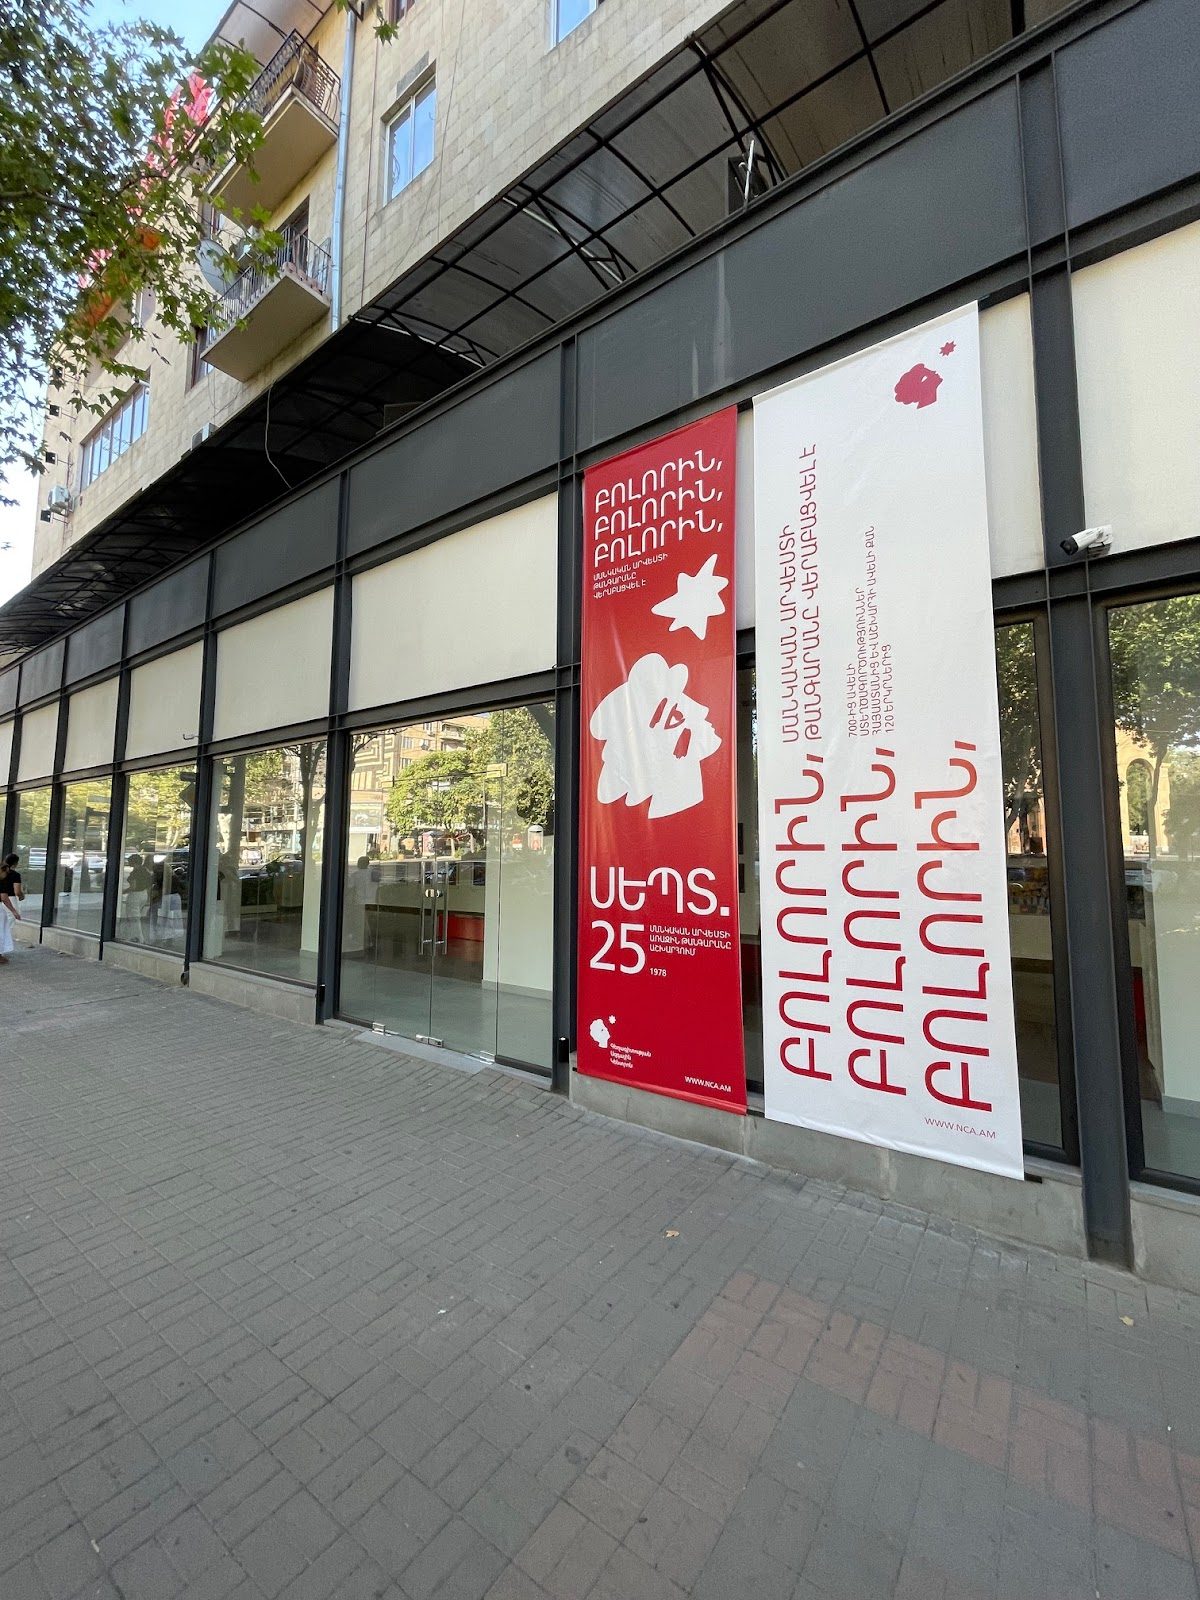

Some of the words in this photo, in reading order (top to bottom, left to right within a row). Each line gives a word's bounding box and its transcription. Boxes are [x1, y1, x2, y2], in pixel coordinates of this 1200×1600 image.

[798, 443, 816, 458] Է
[595, 450, 723, 513] ԲՈԼՈՐԻՆ,
[594, 479, 723, 541] ԲՈԼՈՐԻՆ,
[799, 459, 819, 600] ՎԵՐԱԲԱՑՎԵԼ
[864, 525, 875, 548] ՔԱՆ
[594, 509, 723, 567] ԲՈԼՈՐԻՆ,
[632, 552, 668, 569] ԱՐՎԵՍՏԻ
[778, 524, 797, 621] ԱՐՎԵՍՏԻ
[866, 551, 877, 586] ԱՎԵԼԻ
[867, 588, 879, 640] ԱՇԽԱՐՀԻ
[780, 626, 799, 743] ՄԱՆԿԱԿԱՆ
[801, 605, 822, 741] ԹԱՆԳԱՐԱՆԸ
[846, 663, 857, 699] ԱՎԵԼԻ
[869, 661, 882, 736] ՀԱՅԱՍՏԱՆԻՑ
[881, 644, 894, 712] ԵՐԿՐՆԵՐԻՑ
[884, 715, 895, 734] 120
[590, 866, 730, 917] ՍԵՊՏ.
[774, 753, 832, 1081] ԲՈԼՈՐԻՆ,
[589, 920, 646, 974] 25
[649, 925, 691, 936] ՄԱՆԿԱԿԱՆ
[691, 928, 731, 939] ԱՐՎԵՍՏԻ
[649, 934, 681, 945] ԱՌԱՋԻՆ
[681, 937, 732, 950] ԹԱՆԳԱՐԱՆԸ
[840, 747, 907, 1096] ԲՈԼՈՐԻՆ,
[914, 740, 992, 1112] ԲՈԼՈՐԻՆ,
[649, 967, 667, 977] 1978
[684, 1075, 732, 1093] WWW.NCA.AM
[924, 1116, 996, 1140] WWW.NCA.AM
